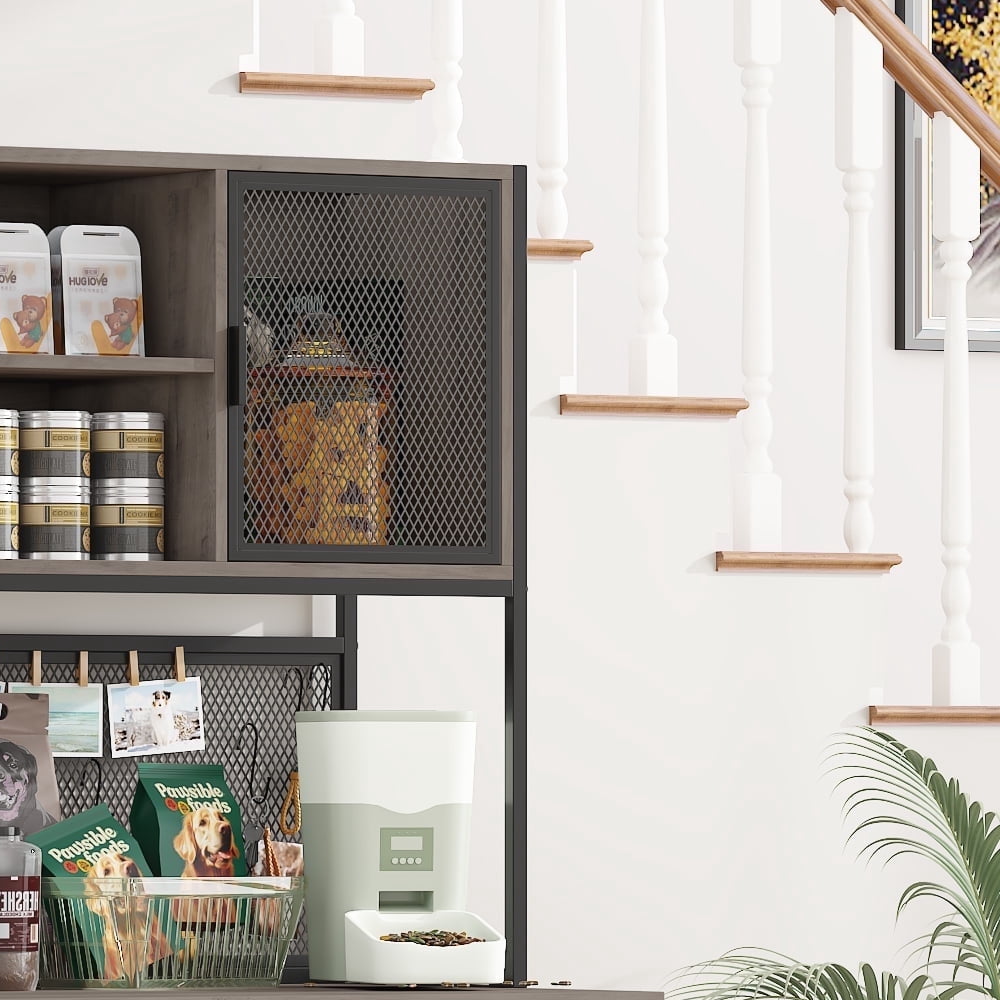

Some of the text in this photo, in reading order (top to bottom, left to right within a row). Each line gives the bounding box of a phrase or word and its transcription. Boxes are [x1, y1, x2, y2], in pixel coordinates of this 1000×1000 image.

[153, 782, 224, 799] Pawsible
[186, 797, 232, 814] foods
[47, 826, 117, 863] Pawsible
[83, 839, 130, 867] foods
